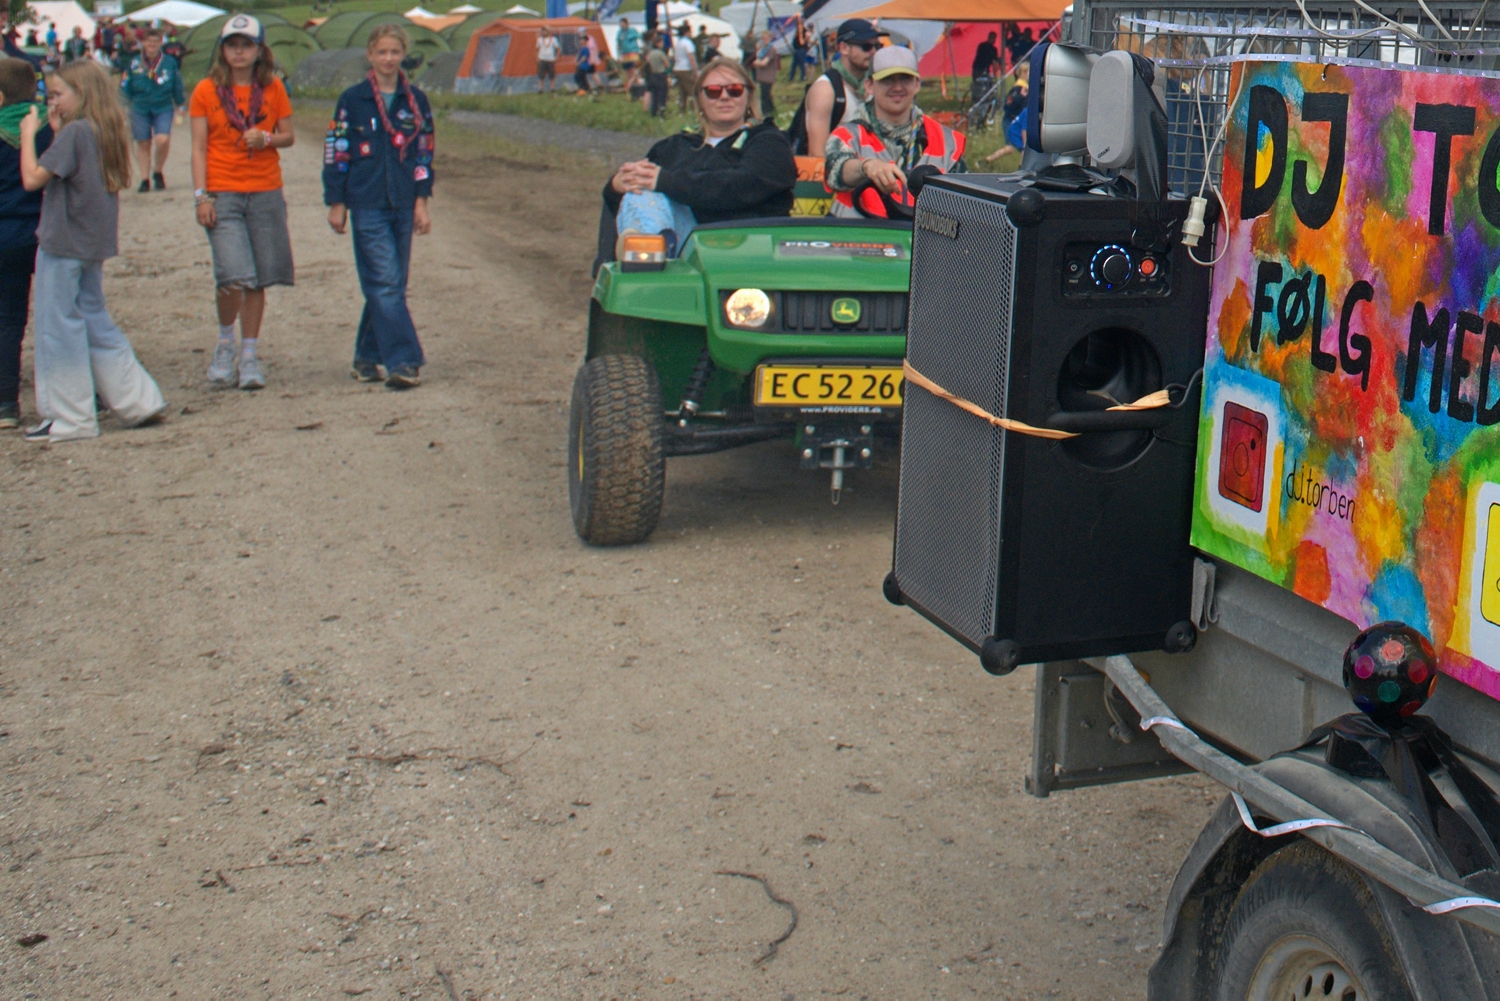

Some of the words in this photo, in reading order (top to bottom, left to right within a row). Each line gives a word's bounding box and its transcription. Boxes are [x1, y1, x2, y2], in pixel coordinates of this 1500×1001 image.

[1241, 84, 1349, 229] DJ
[918, 208, 958, 239] SOUNDBOKS
[1251, 262, 1376, 392] FØLG
[772, 373, 811, 399] EC
[818, 373, 853, 399] 52
[1286, 458, 1356, 524] dj.torben
